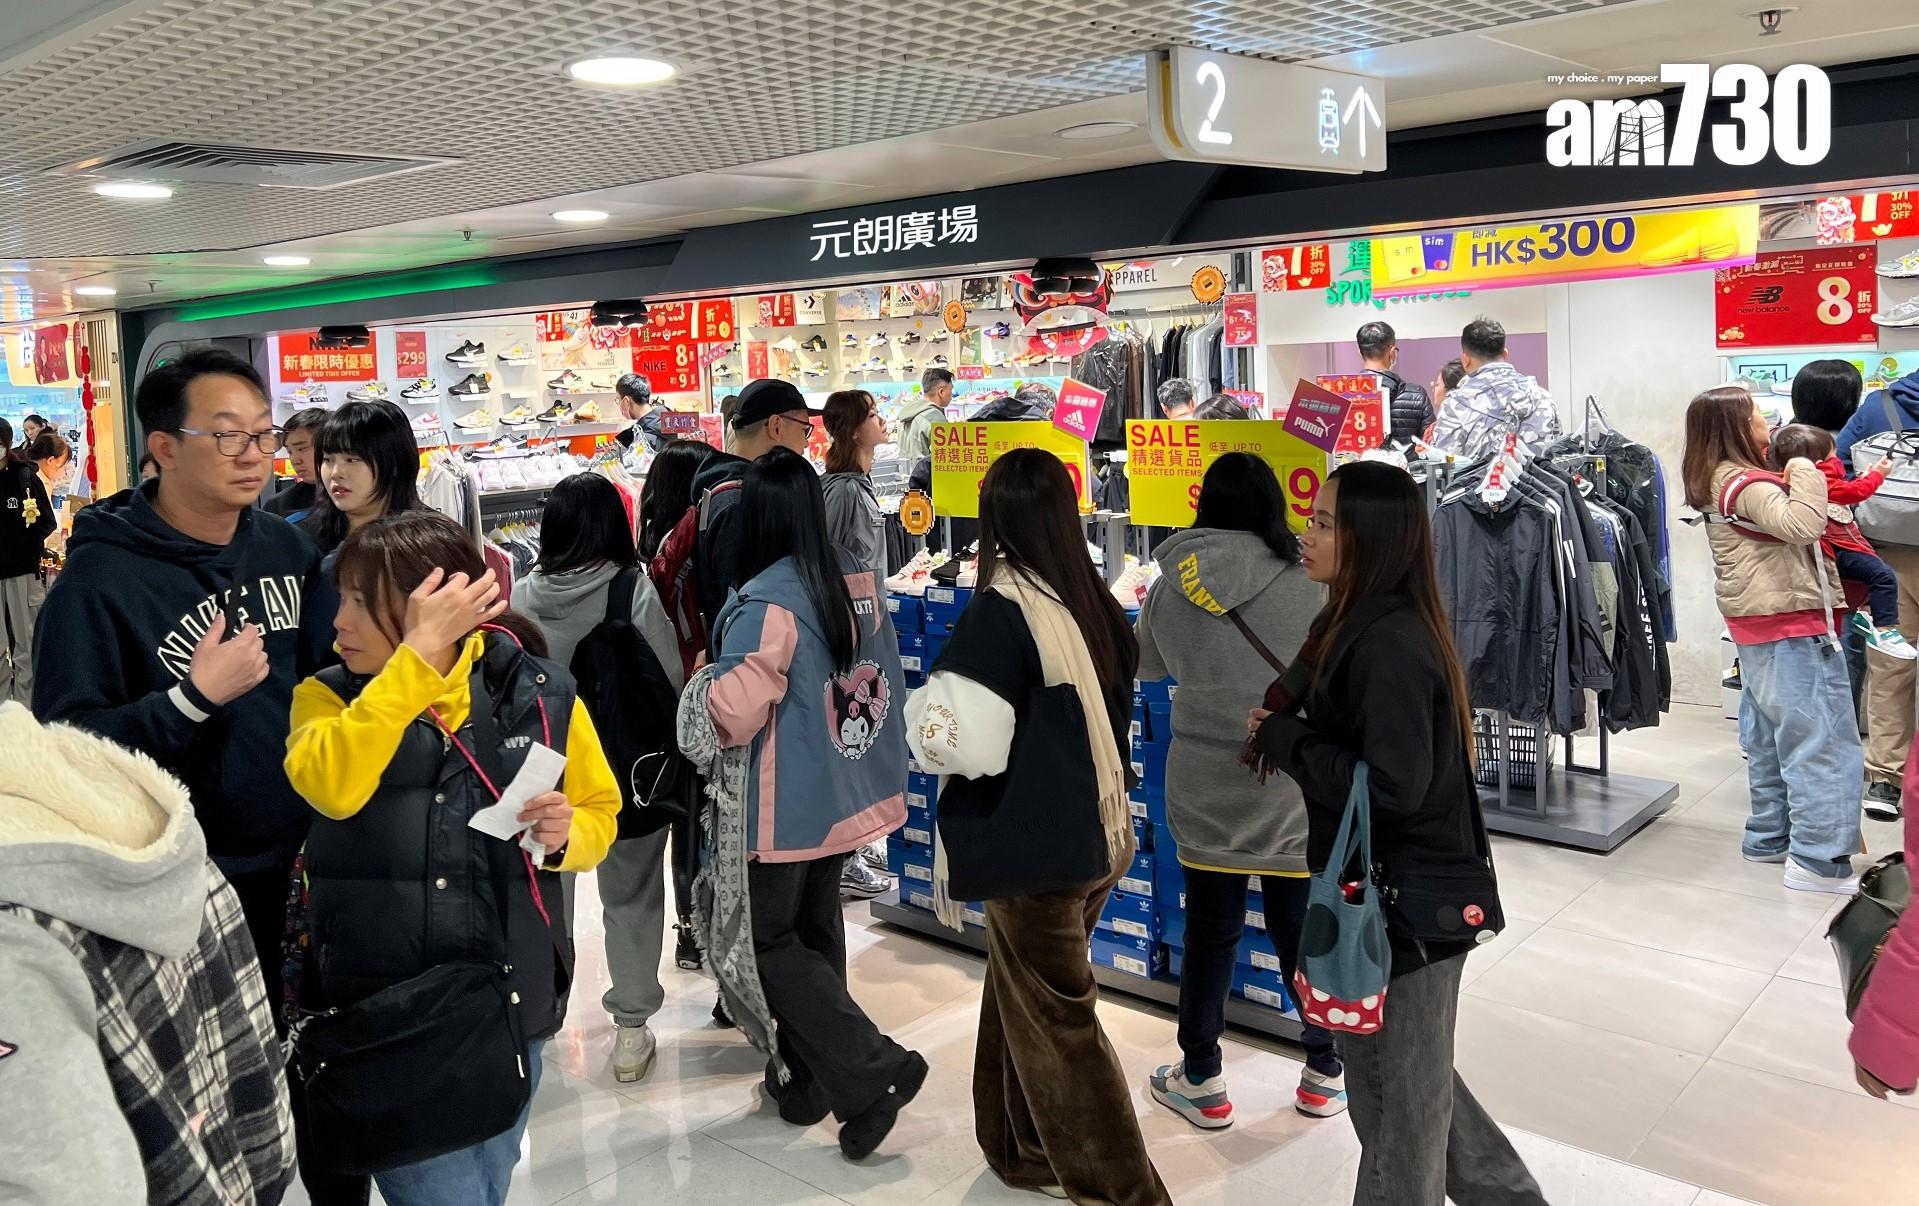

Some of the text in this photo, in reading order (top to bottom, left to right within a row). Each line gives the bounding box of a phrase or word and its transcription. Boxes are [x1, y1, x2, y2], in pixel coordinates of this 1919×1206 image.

[1196, 61, 1232, 145] 2
[1890, 202, 1913, 211] 30%
[1890, 211, 1911, 220] OFF
[810, 204, 978, 262] 元朗廣場
[1425, 236, 1444, 246] sim
[1113, 268, 1157, 286] PPAREL
[1309, 267, 1325, 275] OFF
[1816, 276, 1853, 325] 8
[1737, 305, 1790, 314] new balance
[283, 353, 374, 371] 新春限時優惠
[676, 343, 688, 366] 8
[644, 361, 667, 371] NIKE
[679, 373, 688, 388] 9
[1062, 417, 1086, 432] adidas
[1294, 416, 1324, 438] PUMA
[1353, 411, 1366, 432] 8
[933, 426, 987, 447] SALE
[1130, 424, 1201, 448] SALE
[934, 447, 989, 464] 精選貨品
[1233, 442, 1247, 452] UP
[1249, 442, 1262, 452] TO
[1132, 448, 1202, 467] 精選貨品
[968, 465, 989, 473] ITEMS
[1133, 468, 1202, 477] SELECTED ITEMS
[260, 575, 305, 631] AI
